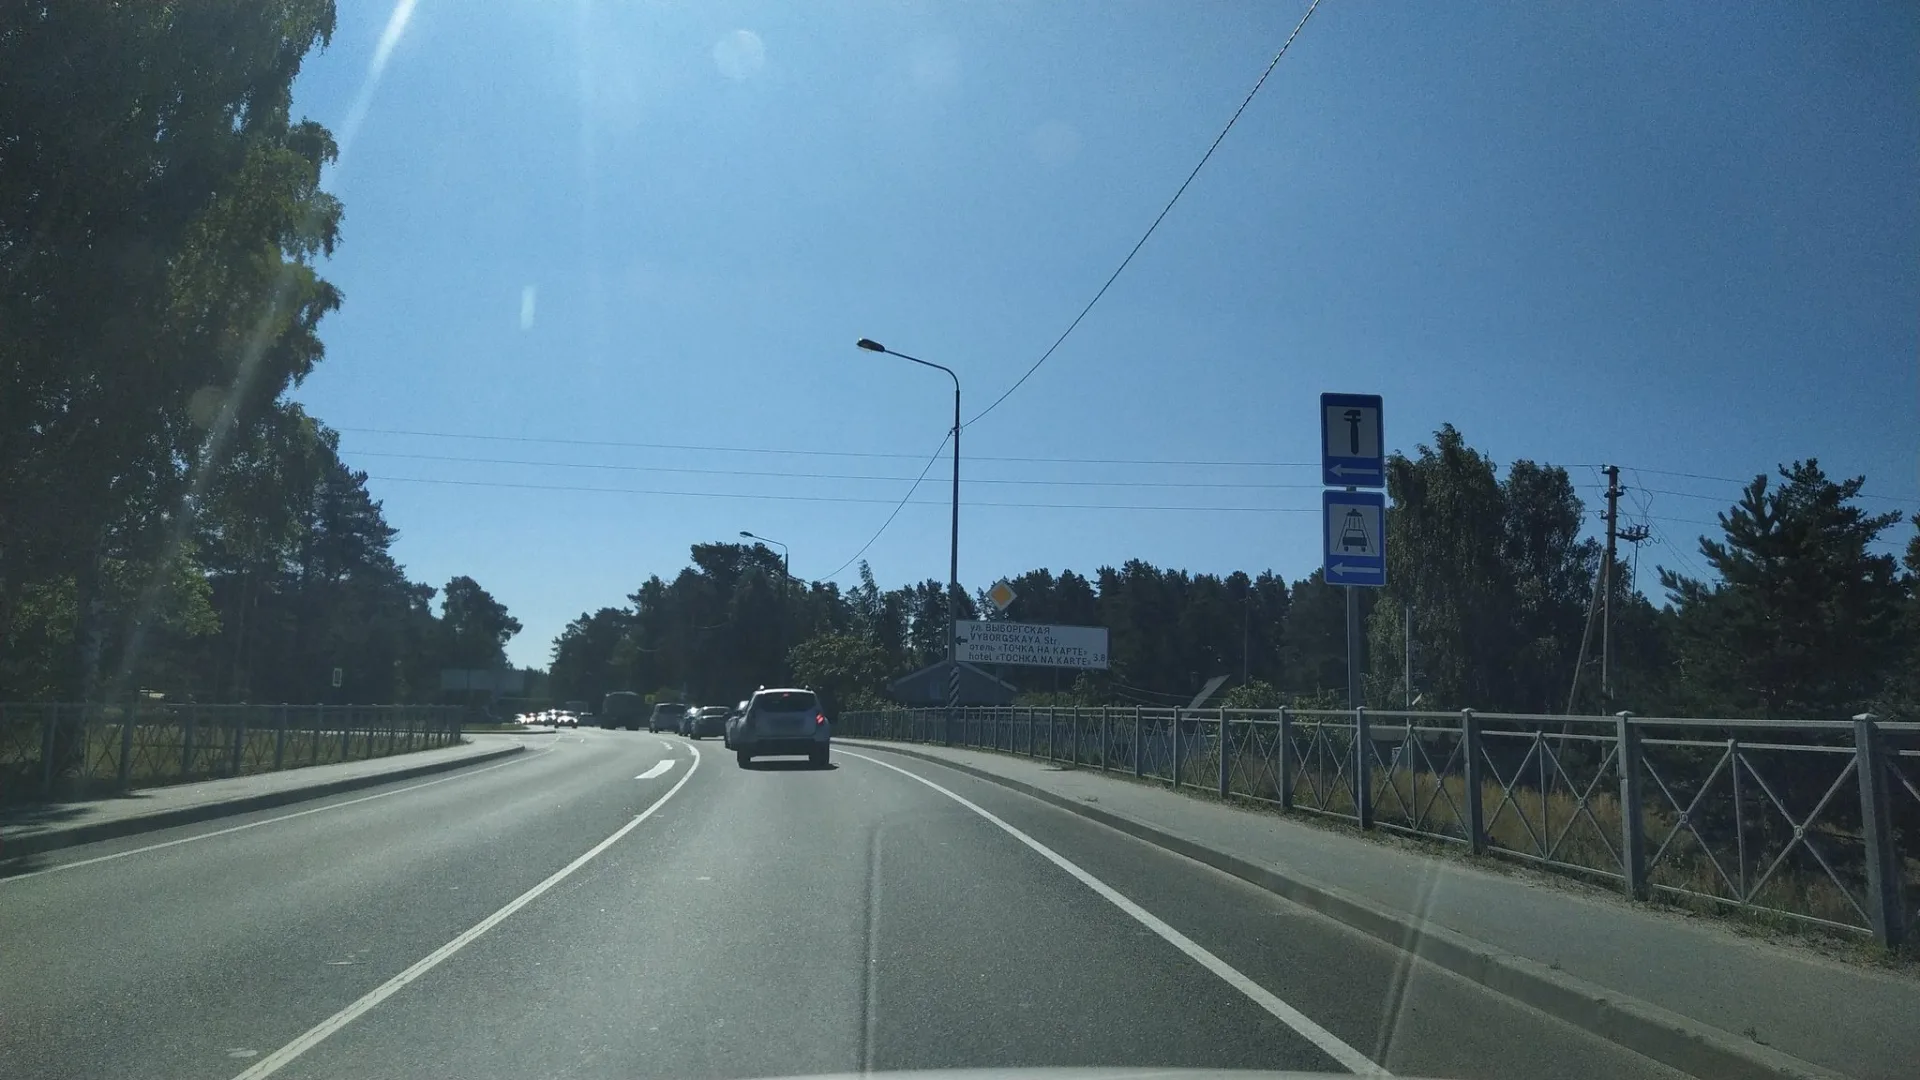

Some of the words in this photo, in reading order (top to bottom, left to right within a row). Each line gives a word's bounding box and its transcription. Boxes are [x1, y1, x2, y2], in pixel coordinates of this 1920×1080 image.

[985, 624, 1050, 634] ВЫБОРГСКАЯ
[970, 633, 1040, 644] VYBORGSKAYA
[970, 644, 995, 652] отель
[1037, 645, 1050, 655] НА
[968, 651, 992, 661] hotel
[1040, 655, 1054, 664] NA
